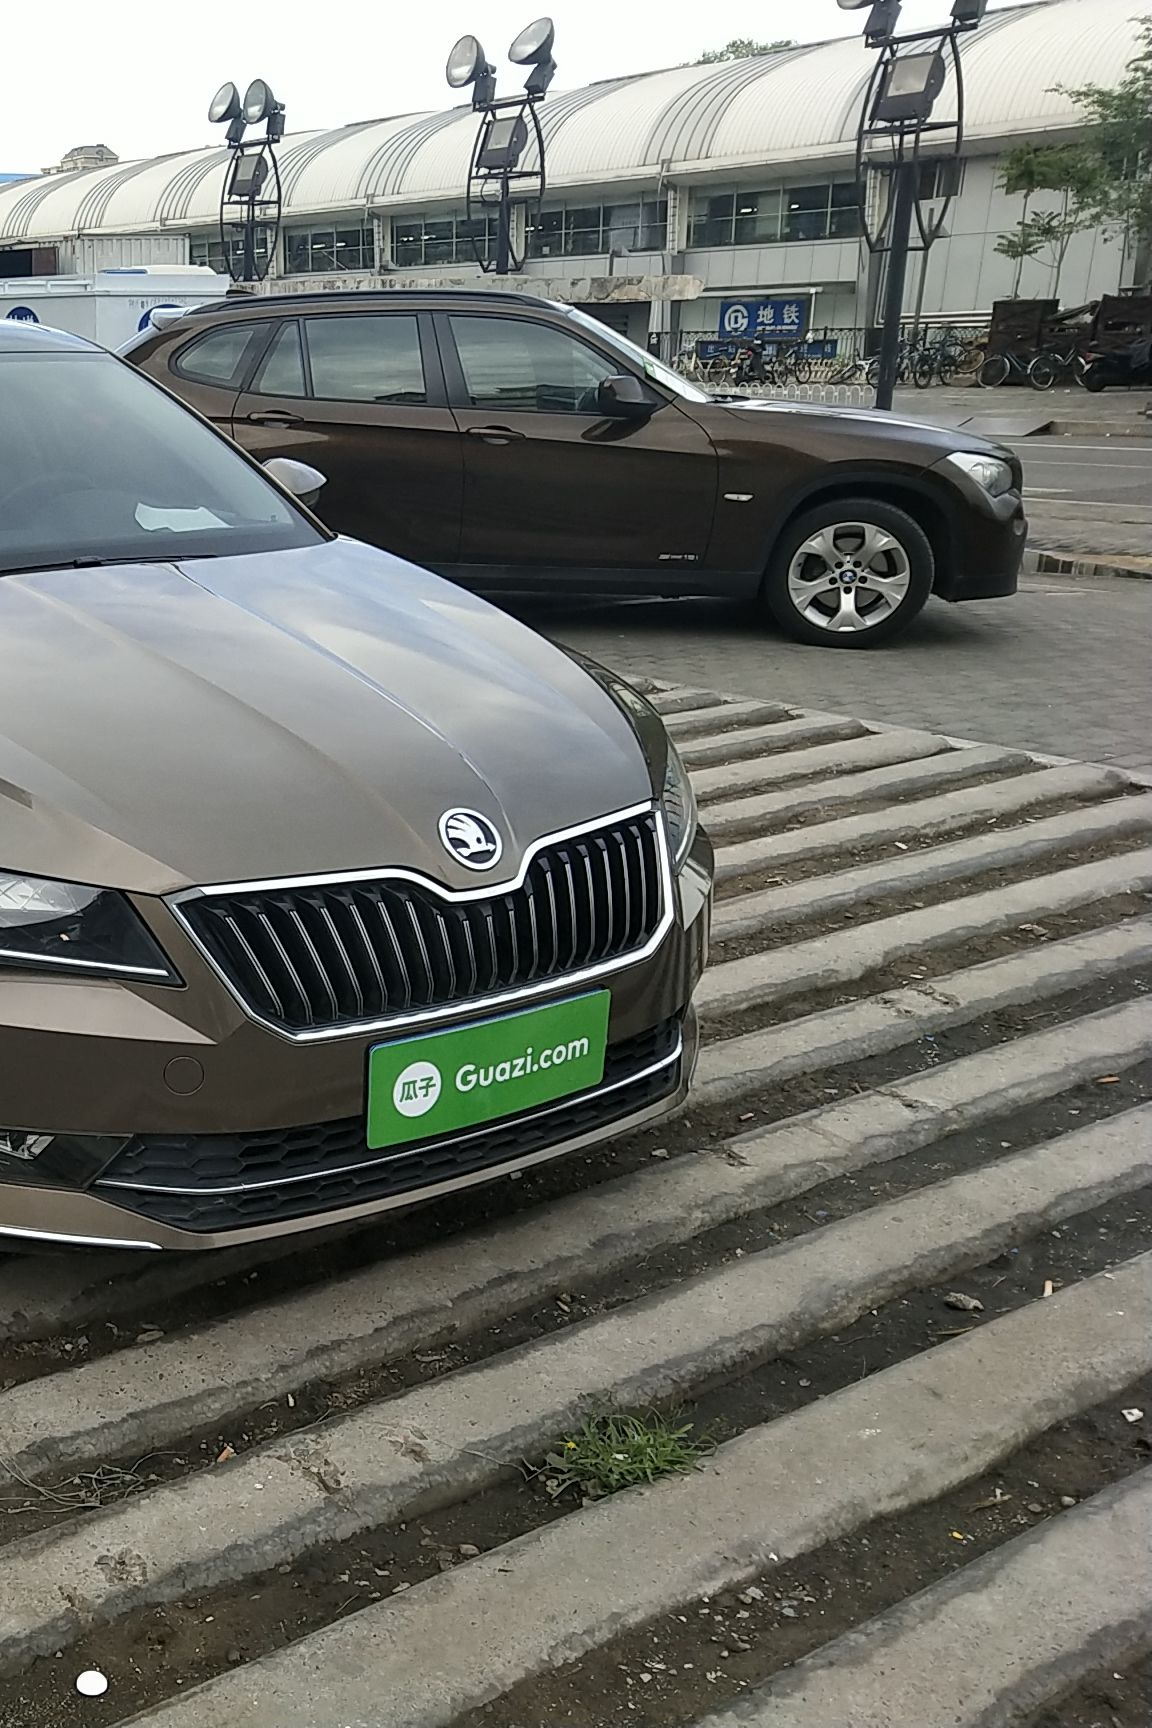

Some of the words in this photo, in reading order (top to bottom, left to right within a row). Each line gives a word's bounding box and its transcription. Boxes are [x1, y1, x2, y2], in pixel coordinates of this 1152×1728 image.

[756, 303, 800, 324] 地铁
[399, 1075, 437, 1104] 瓜子
[455, 1036, 589, 1093] Guazi.com
